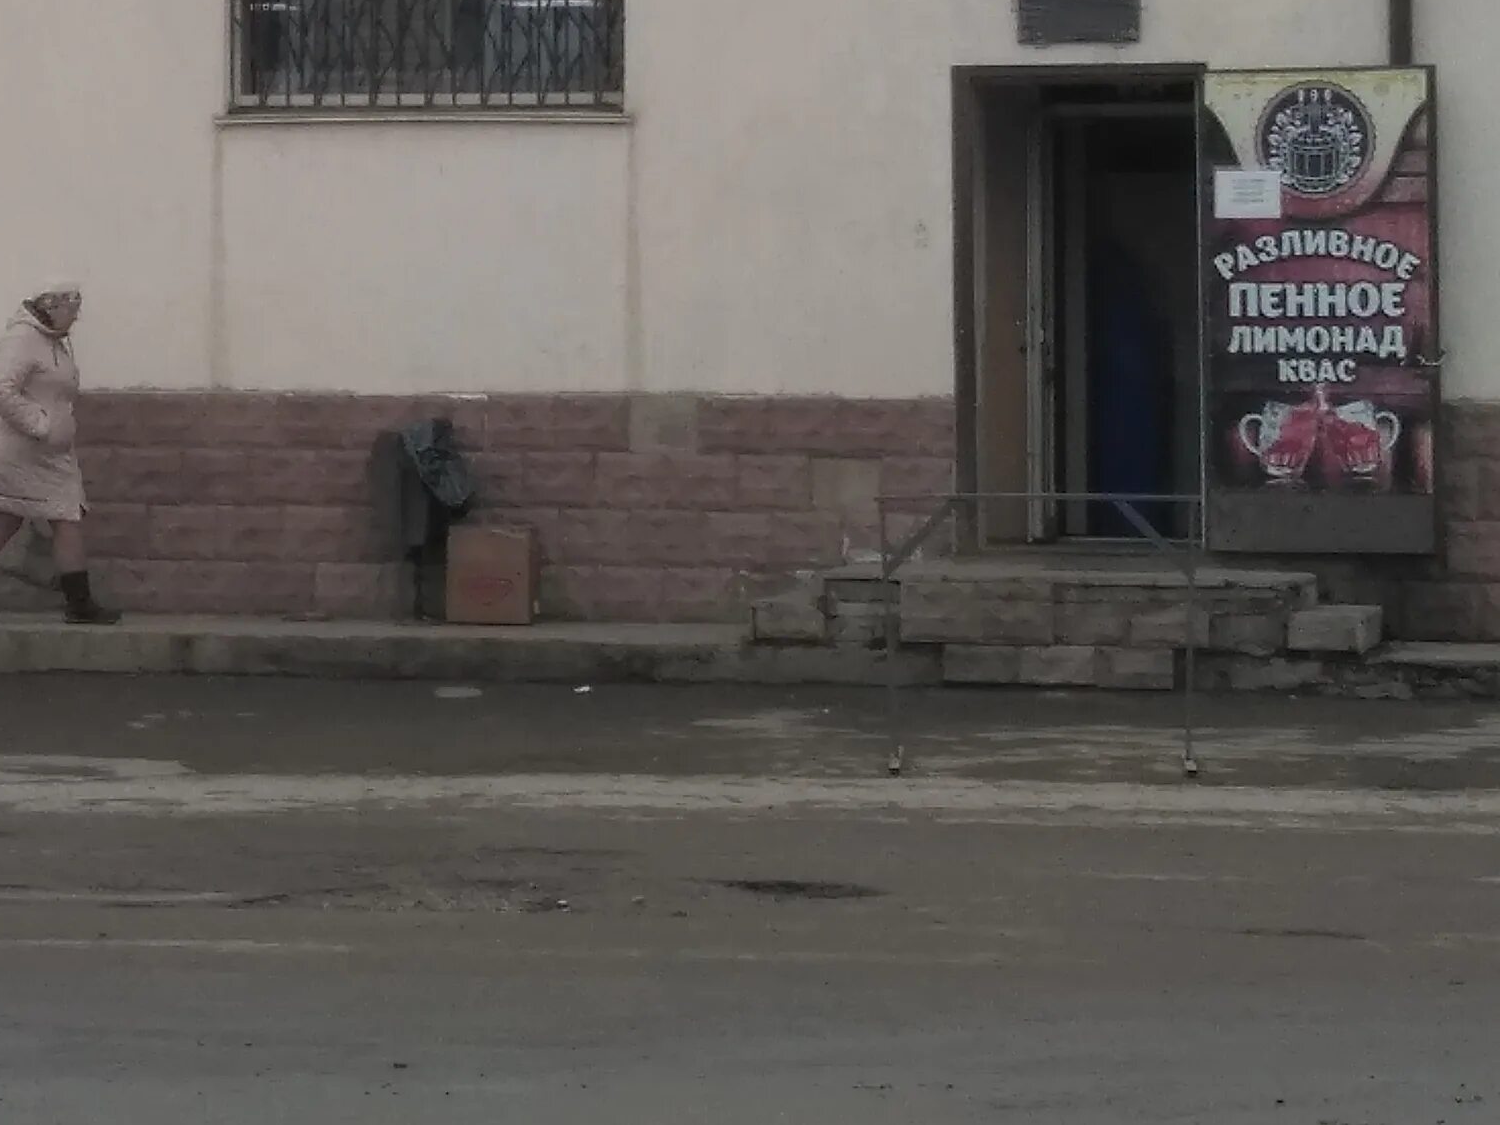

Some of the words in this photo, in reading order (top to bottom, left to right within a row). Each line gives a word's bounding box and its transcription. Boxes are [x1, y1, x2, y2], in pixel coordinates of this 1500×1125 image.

[1214, 229, 1420, 280] РАЗЛИВНОЕ
[1229, 283, 1405, 318] ПЕННОЕ
[1228, 325, 1406, 358] ЛИМОНАД
[1278, 360, 1357, 383] КВАС
